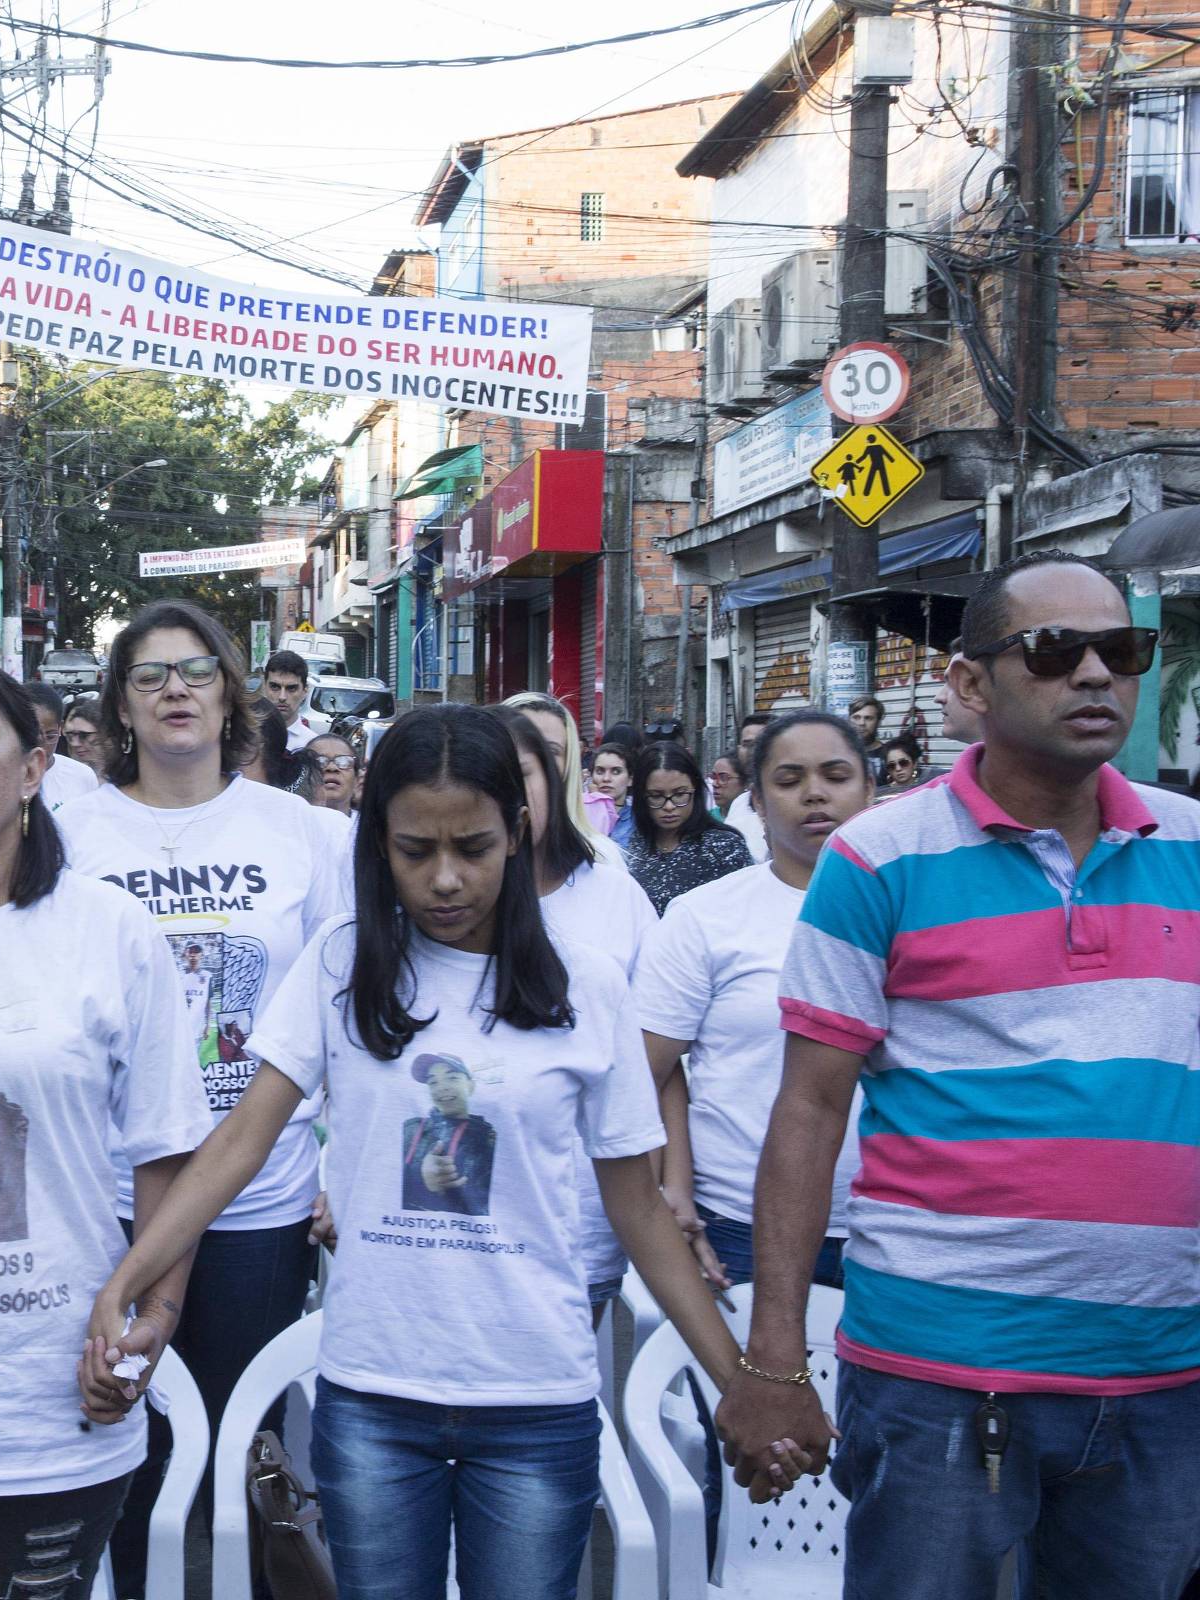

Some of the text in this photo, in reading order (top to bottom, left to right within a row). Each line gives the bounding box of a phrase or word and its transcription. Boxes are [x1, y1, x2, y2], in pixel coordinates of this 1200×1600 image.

[0, 237, 121, 287] DESTRÓI
[128, 268, 146, 293] O
[154, 275, 210, 306] QUE
[219, 292, 372, 327] PRETENDE
[383, 309, 548, 340] DEFENDER!
[25, 282, 92, 317] VIDA
[119, 304, 137, 329] A
[146, 309, 308, 353] LIBERDADE
[317, 335, 357, 358] DO
[367, 339, 421, 365] SER
[431, 345, 563, 380] HUMANO.
[68, 326, 124, 359] PAZ
[132, 339, 202, 370] PELA
[213, 352, 315, 385] MORTE
[323, 365, 382, 393] DOS
[391, 373, 578, 417] INOCENTES!!!
[840, 361, 892, 397] 30
[141, 895, 255, 916] ILHERME
[24, 1252, 34, 1273] 9
